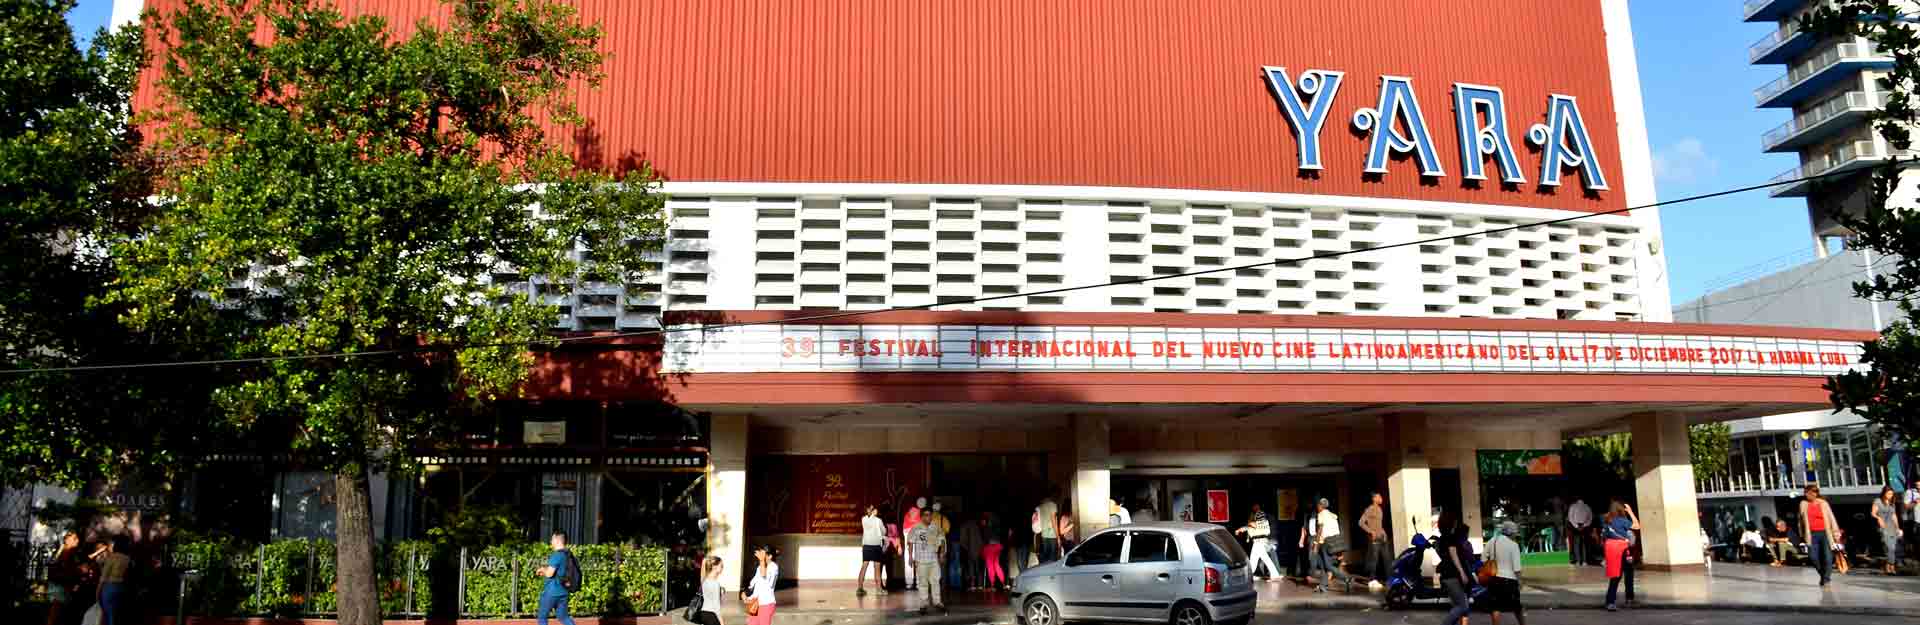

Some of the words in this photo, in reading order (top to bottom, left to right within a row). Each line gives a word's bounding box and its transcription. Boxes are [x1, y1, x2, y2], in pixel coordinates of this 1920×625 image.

[1263, 65, 1609, 191] YARA
[782, 337, 815, 358] 39
[838, 338, 943, 357] FESTIVAL
[970, 339, 1137, 358] INTERNACIONAL
[1152, 340, 1192, 358] DEL
[1202, 340, 1264, 358] NUEVO
[1272, 341, 1317, 358] CINE
[1328, 342, 1500, 360] LATINOAMERICANO
[1507, 344, 1539, 361] DEL
[1545, 345, 1555, 361] 8
[1558, 346, 1579, 361] AL
[1582, 345, 1599, 363] 17
[1604, 346, 1624, 361] DE
[1629, 346, 1703, 363] DICIEMBRE
[1708, 347, 1743, 365] 2017
[1748, 350, 1765, 365] LA
[1769, 350, 1815, 365] HABANA
[1819, 351, 1849, 366] CUBA
[472, 556, 508, 571] YARA
